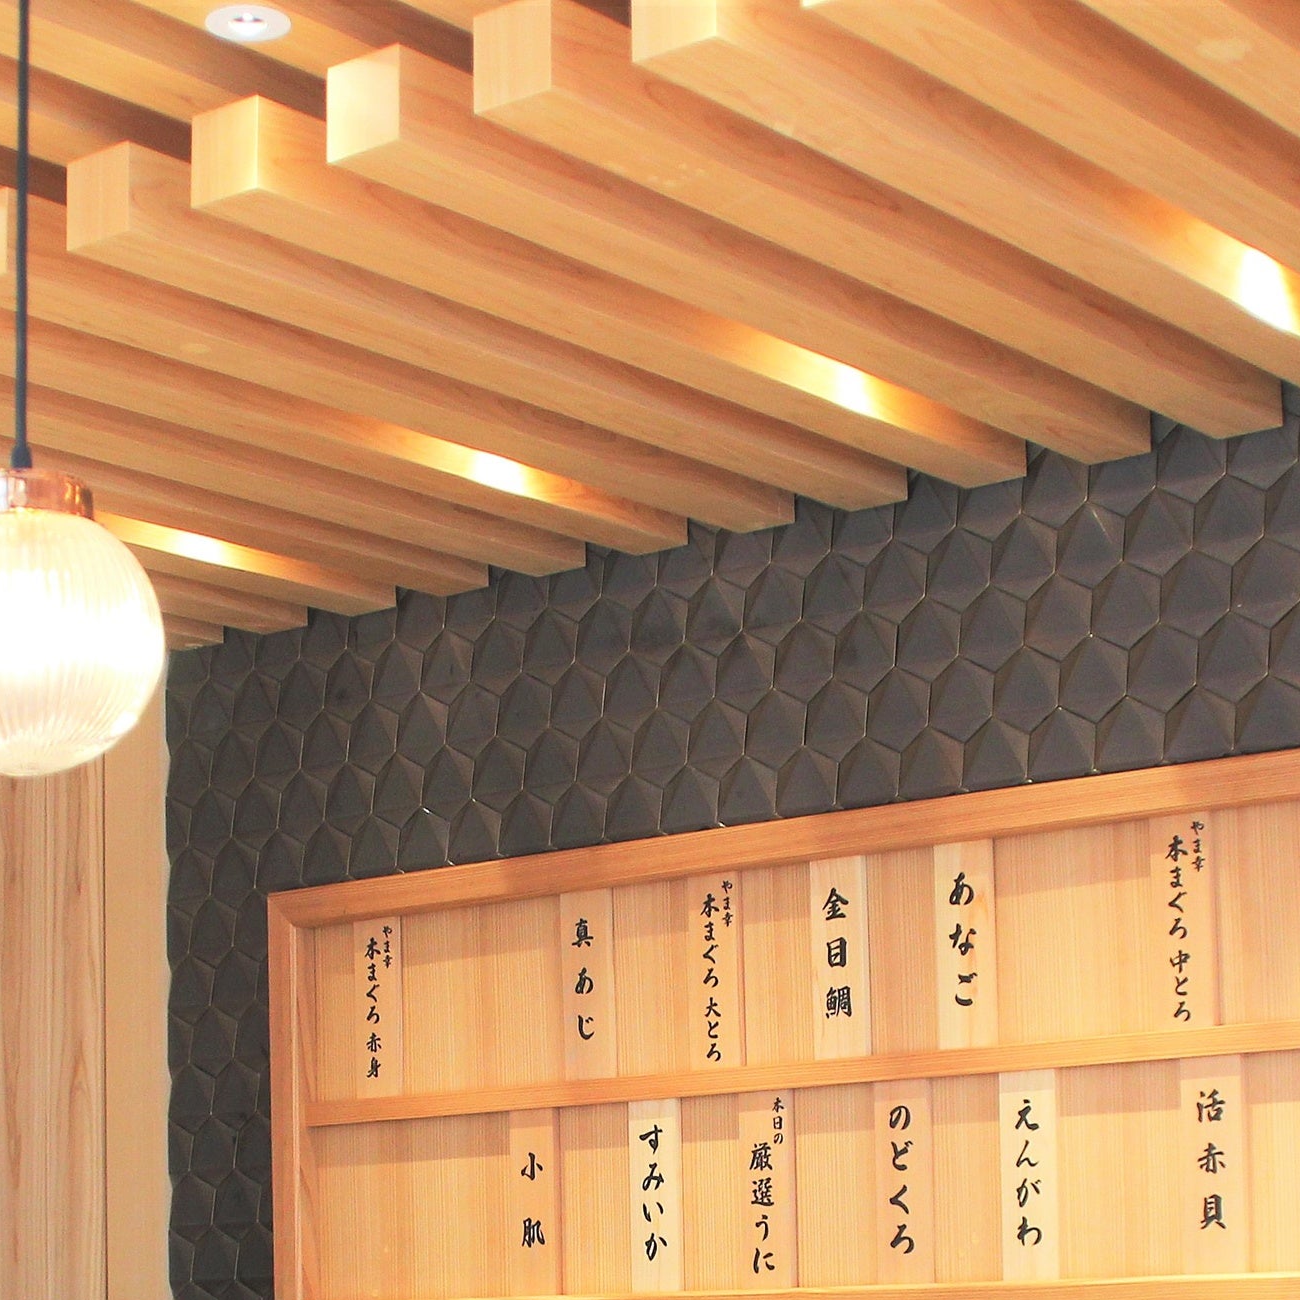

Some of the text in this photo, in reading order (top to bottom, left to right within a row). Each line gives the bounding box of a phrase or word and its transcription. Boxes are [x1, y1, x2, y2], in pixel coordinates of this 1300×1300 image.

[721, 880, 733, 927] やま幸
[1190, 821, 1205, 872] やま幸
[382, 925, 393, 969] やま幸
[571, 918, 595, 1041] 真あじ
[822, 887, 852, 1019] 金目鯛
[948, 871, 978, 1007] あなご
[772, 1097, 785, 1144] 本日の
[889, 1105, 915, 1255] のどくろ
[1014, 1099, 1042, 1246] えんがわ
[1196, 1088, 1226, 1230] 活赤貝
[520, 1152, 546, 1248] 小肌
[638, 1124, 668, 1262] すみいか
[749, 1142, 776, 1275] 厳選うに
